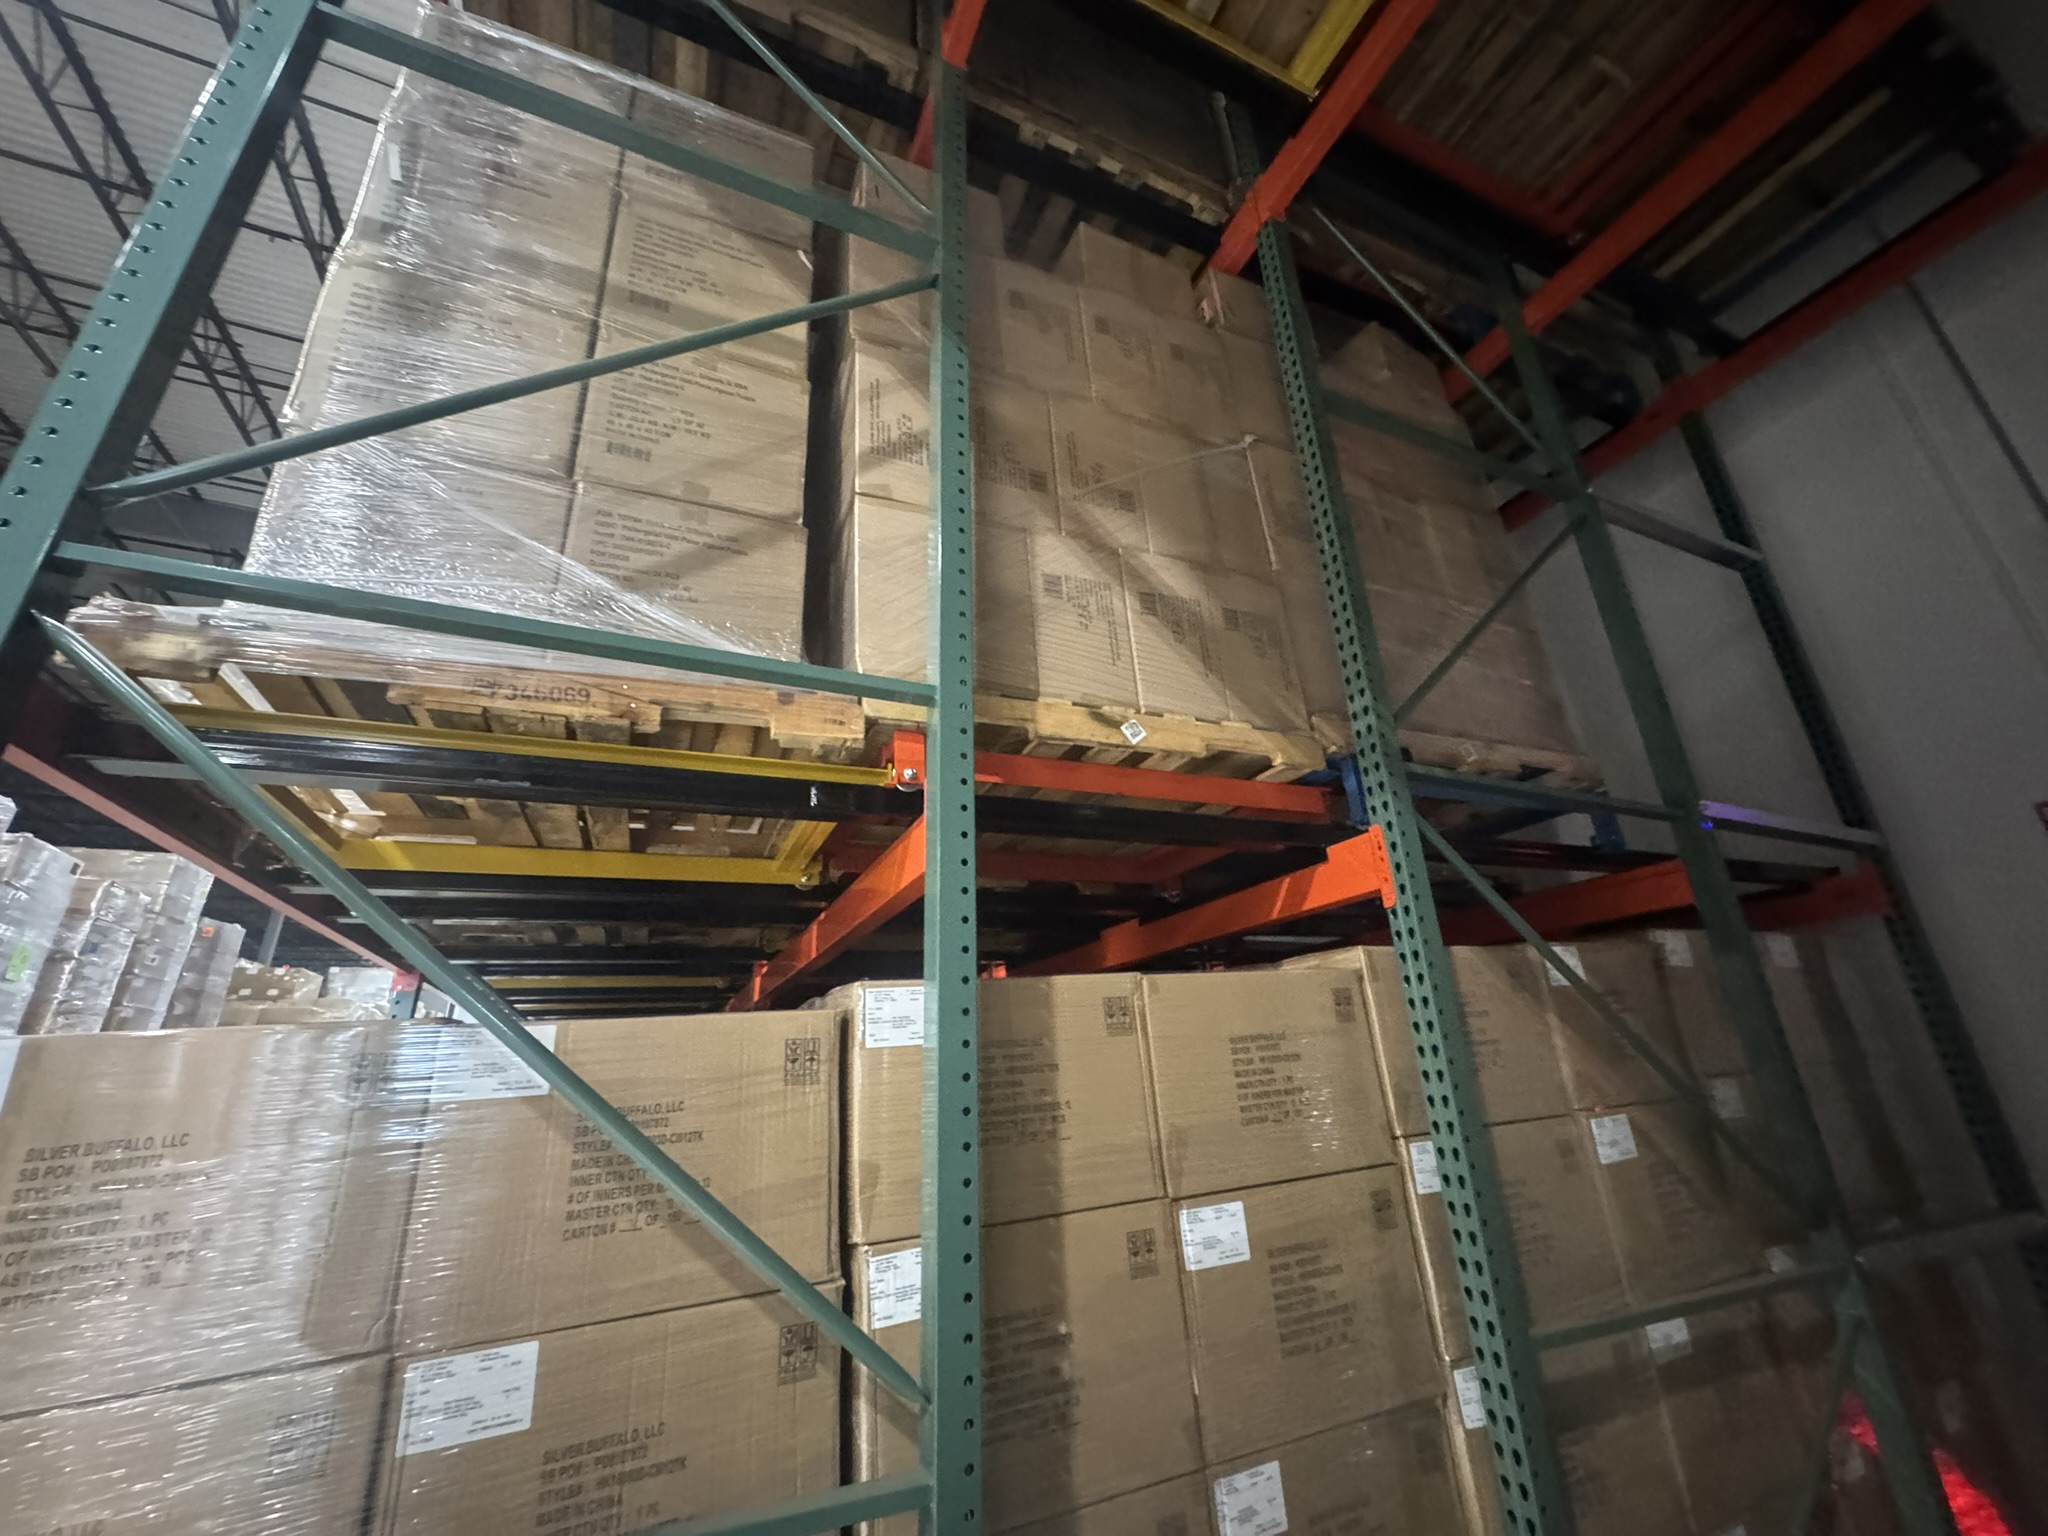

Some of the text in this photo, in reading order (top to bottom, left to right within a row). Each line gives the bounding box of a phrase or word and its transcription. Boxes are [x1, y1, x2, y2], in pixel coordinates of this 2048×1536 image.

[665, 1100, 685, 1114] LLC
[23, 1143, 81, 1164] SILVER
[161, 1132, 190, 1149] LLC
[570, 1155, 603, 1171] MADE
[18, 1166, 40, 1183] SB
[575, 1190, 591, 1204] OF
[592, 1185, 633, 1202] INNERS
[634, 1182, 655, 1197] PER
[565, 1204, 611, 1222] MASTER
[562, 1222, 608, 1242] CARTON
[644, 1213, 660, 1227] OF
